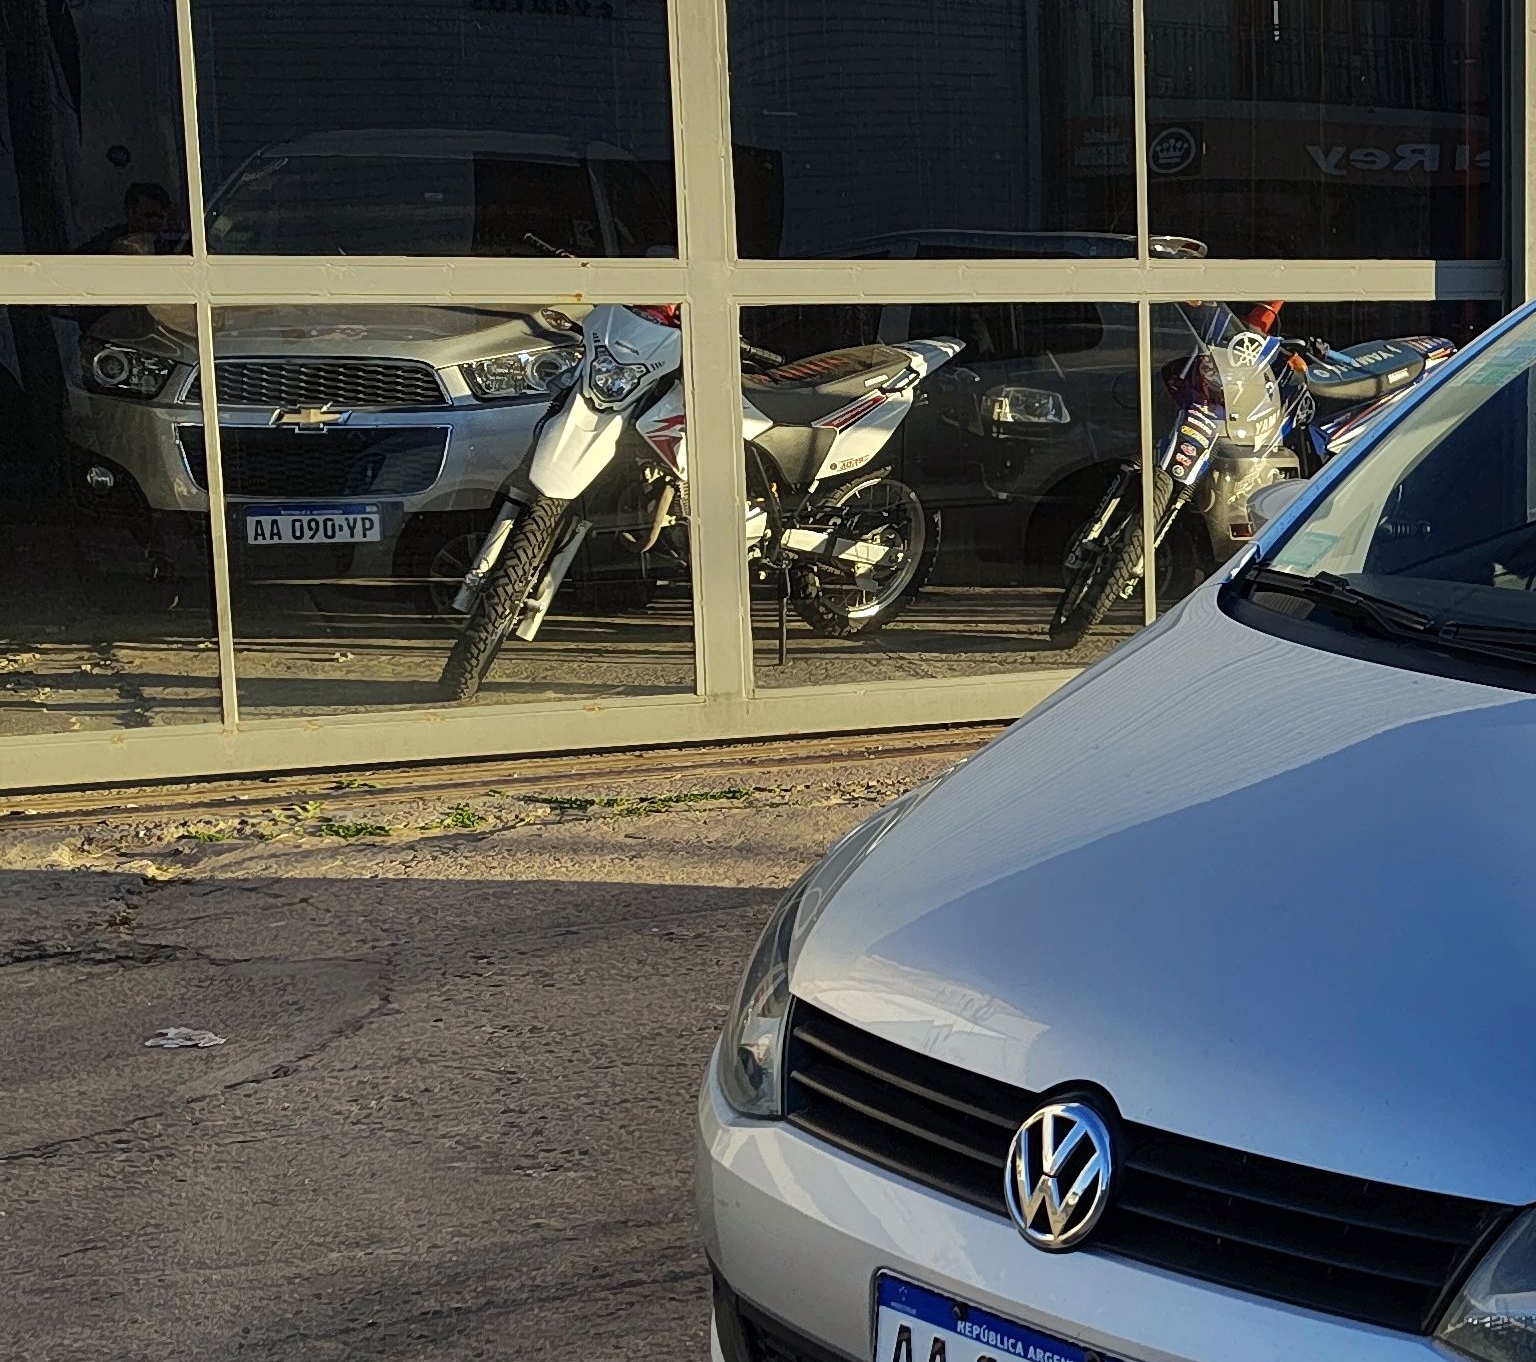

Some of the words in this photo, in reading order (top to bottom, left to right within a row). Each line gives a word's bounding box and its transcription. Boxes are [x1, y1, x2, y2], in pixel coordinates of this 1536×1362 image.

[253, 519, 282, 541] AA
[291, 518, 336, 540] 090
[345, 517, 374, 539] YP
[957, 1319, 1024, 1357] REPÚBLICA
